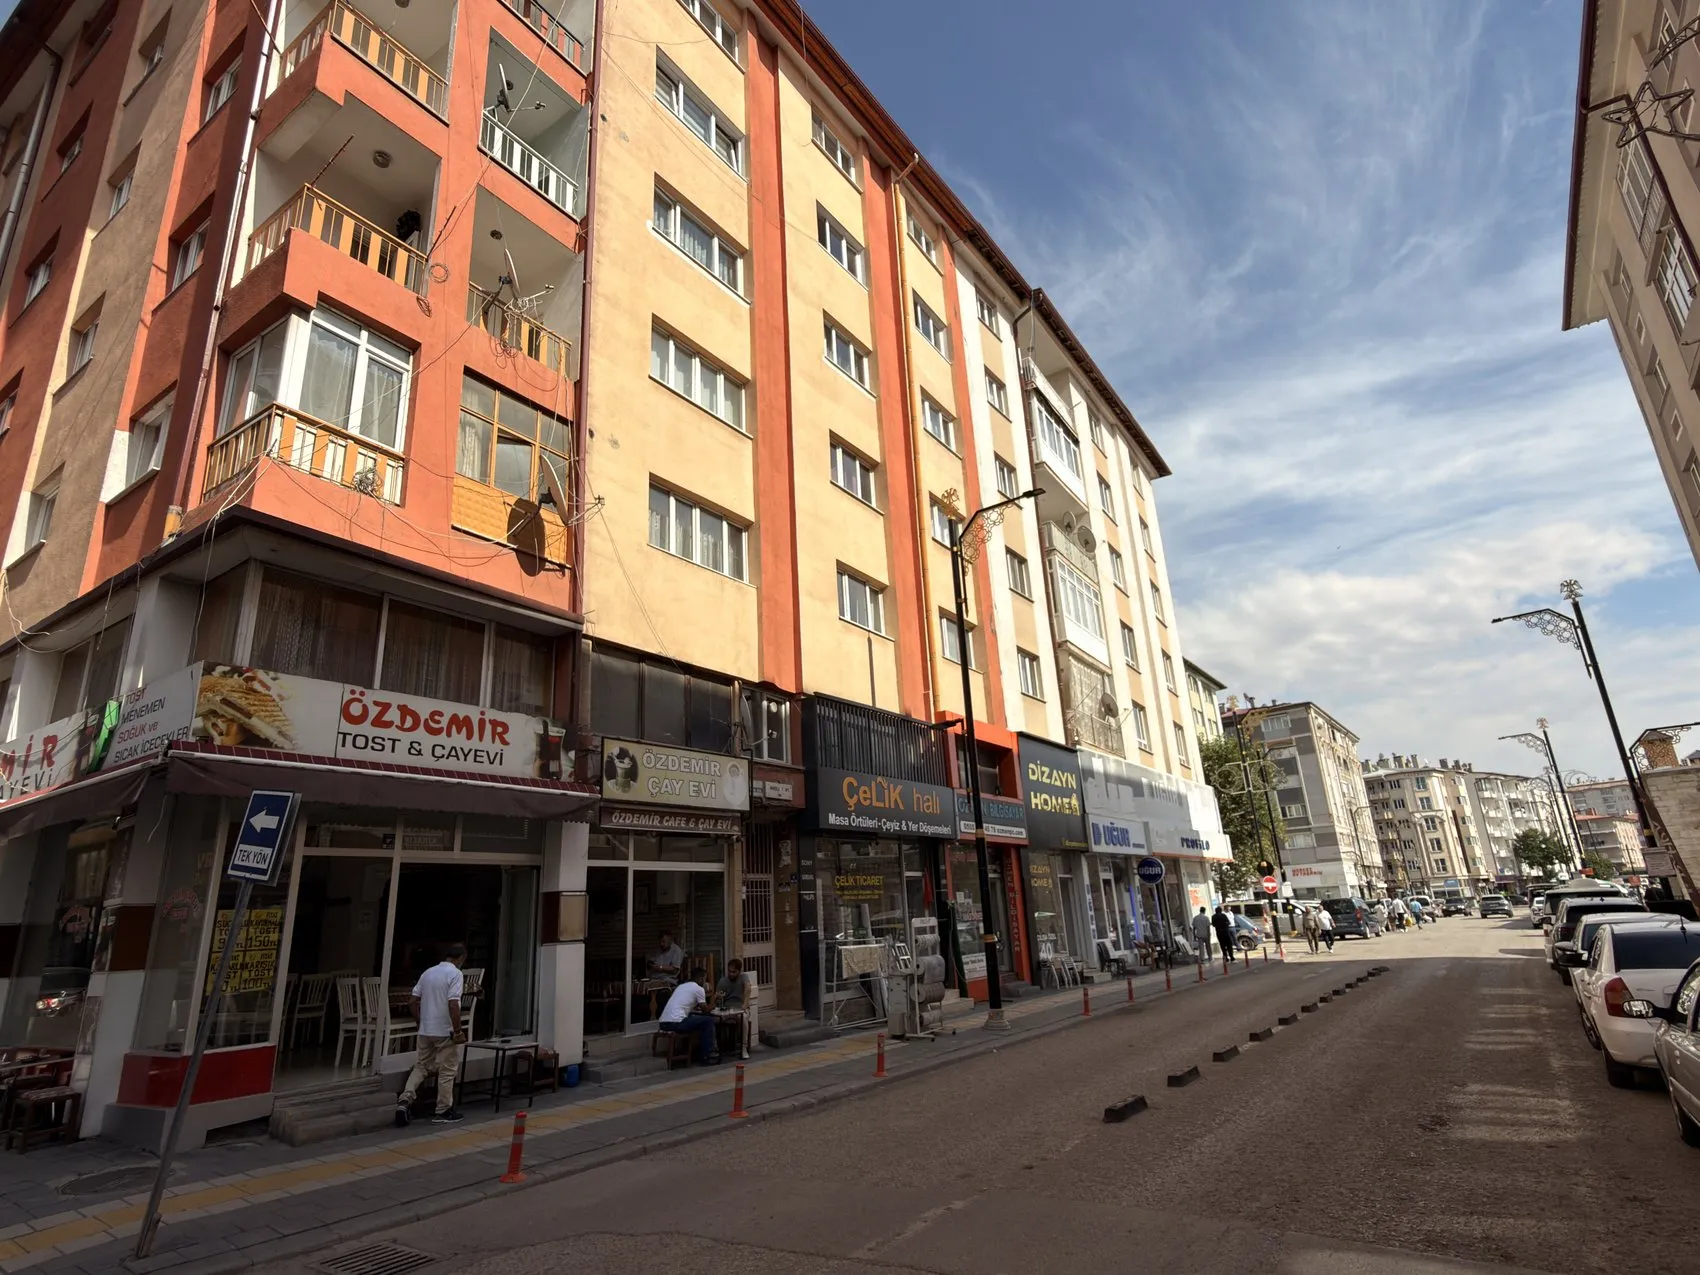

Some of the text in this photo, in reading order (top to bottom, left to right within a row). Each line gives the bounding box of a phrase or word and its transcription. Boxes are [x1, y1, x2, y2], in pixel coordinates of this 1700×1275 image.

[122, 697, 166, 724] MENEMEN
[342, 689, 510, 745] ÖZDEMİR
[338, 731, 504, 766] TOST & ÇAYEVİ
[642, 748, 722, 777] ÖZDEMİR
[1028, 760, 1076, 789] DİZAYN
[647, 777, 717, 799] ÇAY EVİ
[1031, 791, 1071, 815] HOME
[612, 810, 661, 826] ÖZDEMİR
[663, 815, 687, 828] CAFE
[698, 817, 716, 830] ÇAY
[717, 817, 732, 829] EVİ
[828, 812, 849, 826] Masa
[901, 820, 907, 831] &
[908, 821, 919, 832] Yer
[919, 822, 952, 836] Döşemeleri
[1103, 822, 1131, 848] UĞUR
[238, 849, 269, 865] TEK YÖN
[247, 936, 270, 949] 150
[253, 927, 278, 936] TOST
[247, 968, 273, 977] TOST
